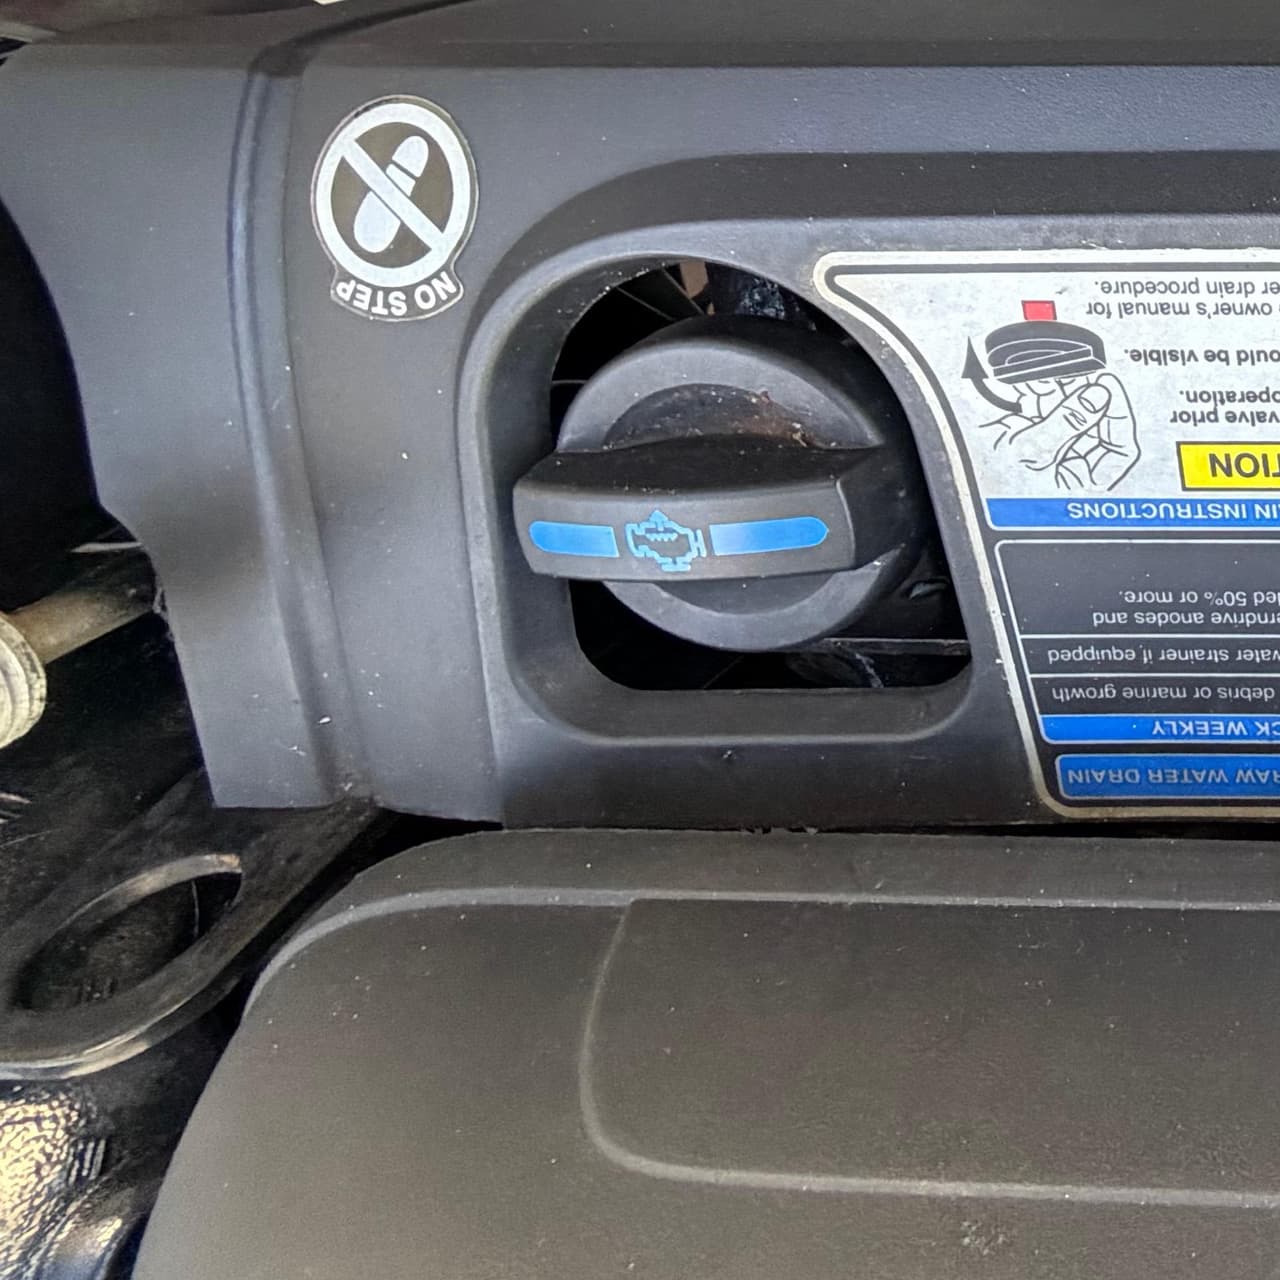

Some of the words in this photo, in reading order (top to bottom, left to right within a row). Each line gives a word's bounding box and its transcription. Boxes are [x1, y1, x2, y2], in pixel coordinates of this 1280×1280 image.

[335, 278, 408, 316] STEP
[413, 271, 457, 310] NO
[1094, 277, 1200, 299] procedure.
[1206, 281, 1256, 299] drain
[1085, 301, 1113, 319] for
[1117, 301, 1190, 320] manual
[1195, 302, 1273, 320] owner's
[1124, 348, 1199, 367] visible.
[1203, 349, 1230, 367] be
[1169, 406, 1220, 427] prior
[1224, 410, 1280, 427] valve
[1067, 502, 1247, 519] INSTRUCTIONS
[1152, 720, 1248, 736] WEEKLY
[1067, 768, 1141, 784] DRAIN
[1147, 768, 1229, 784] WATER
